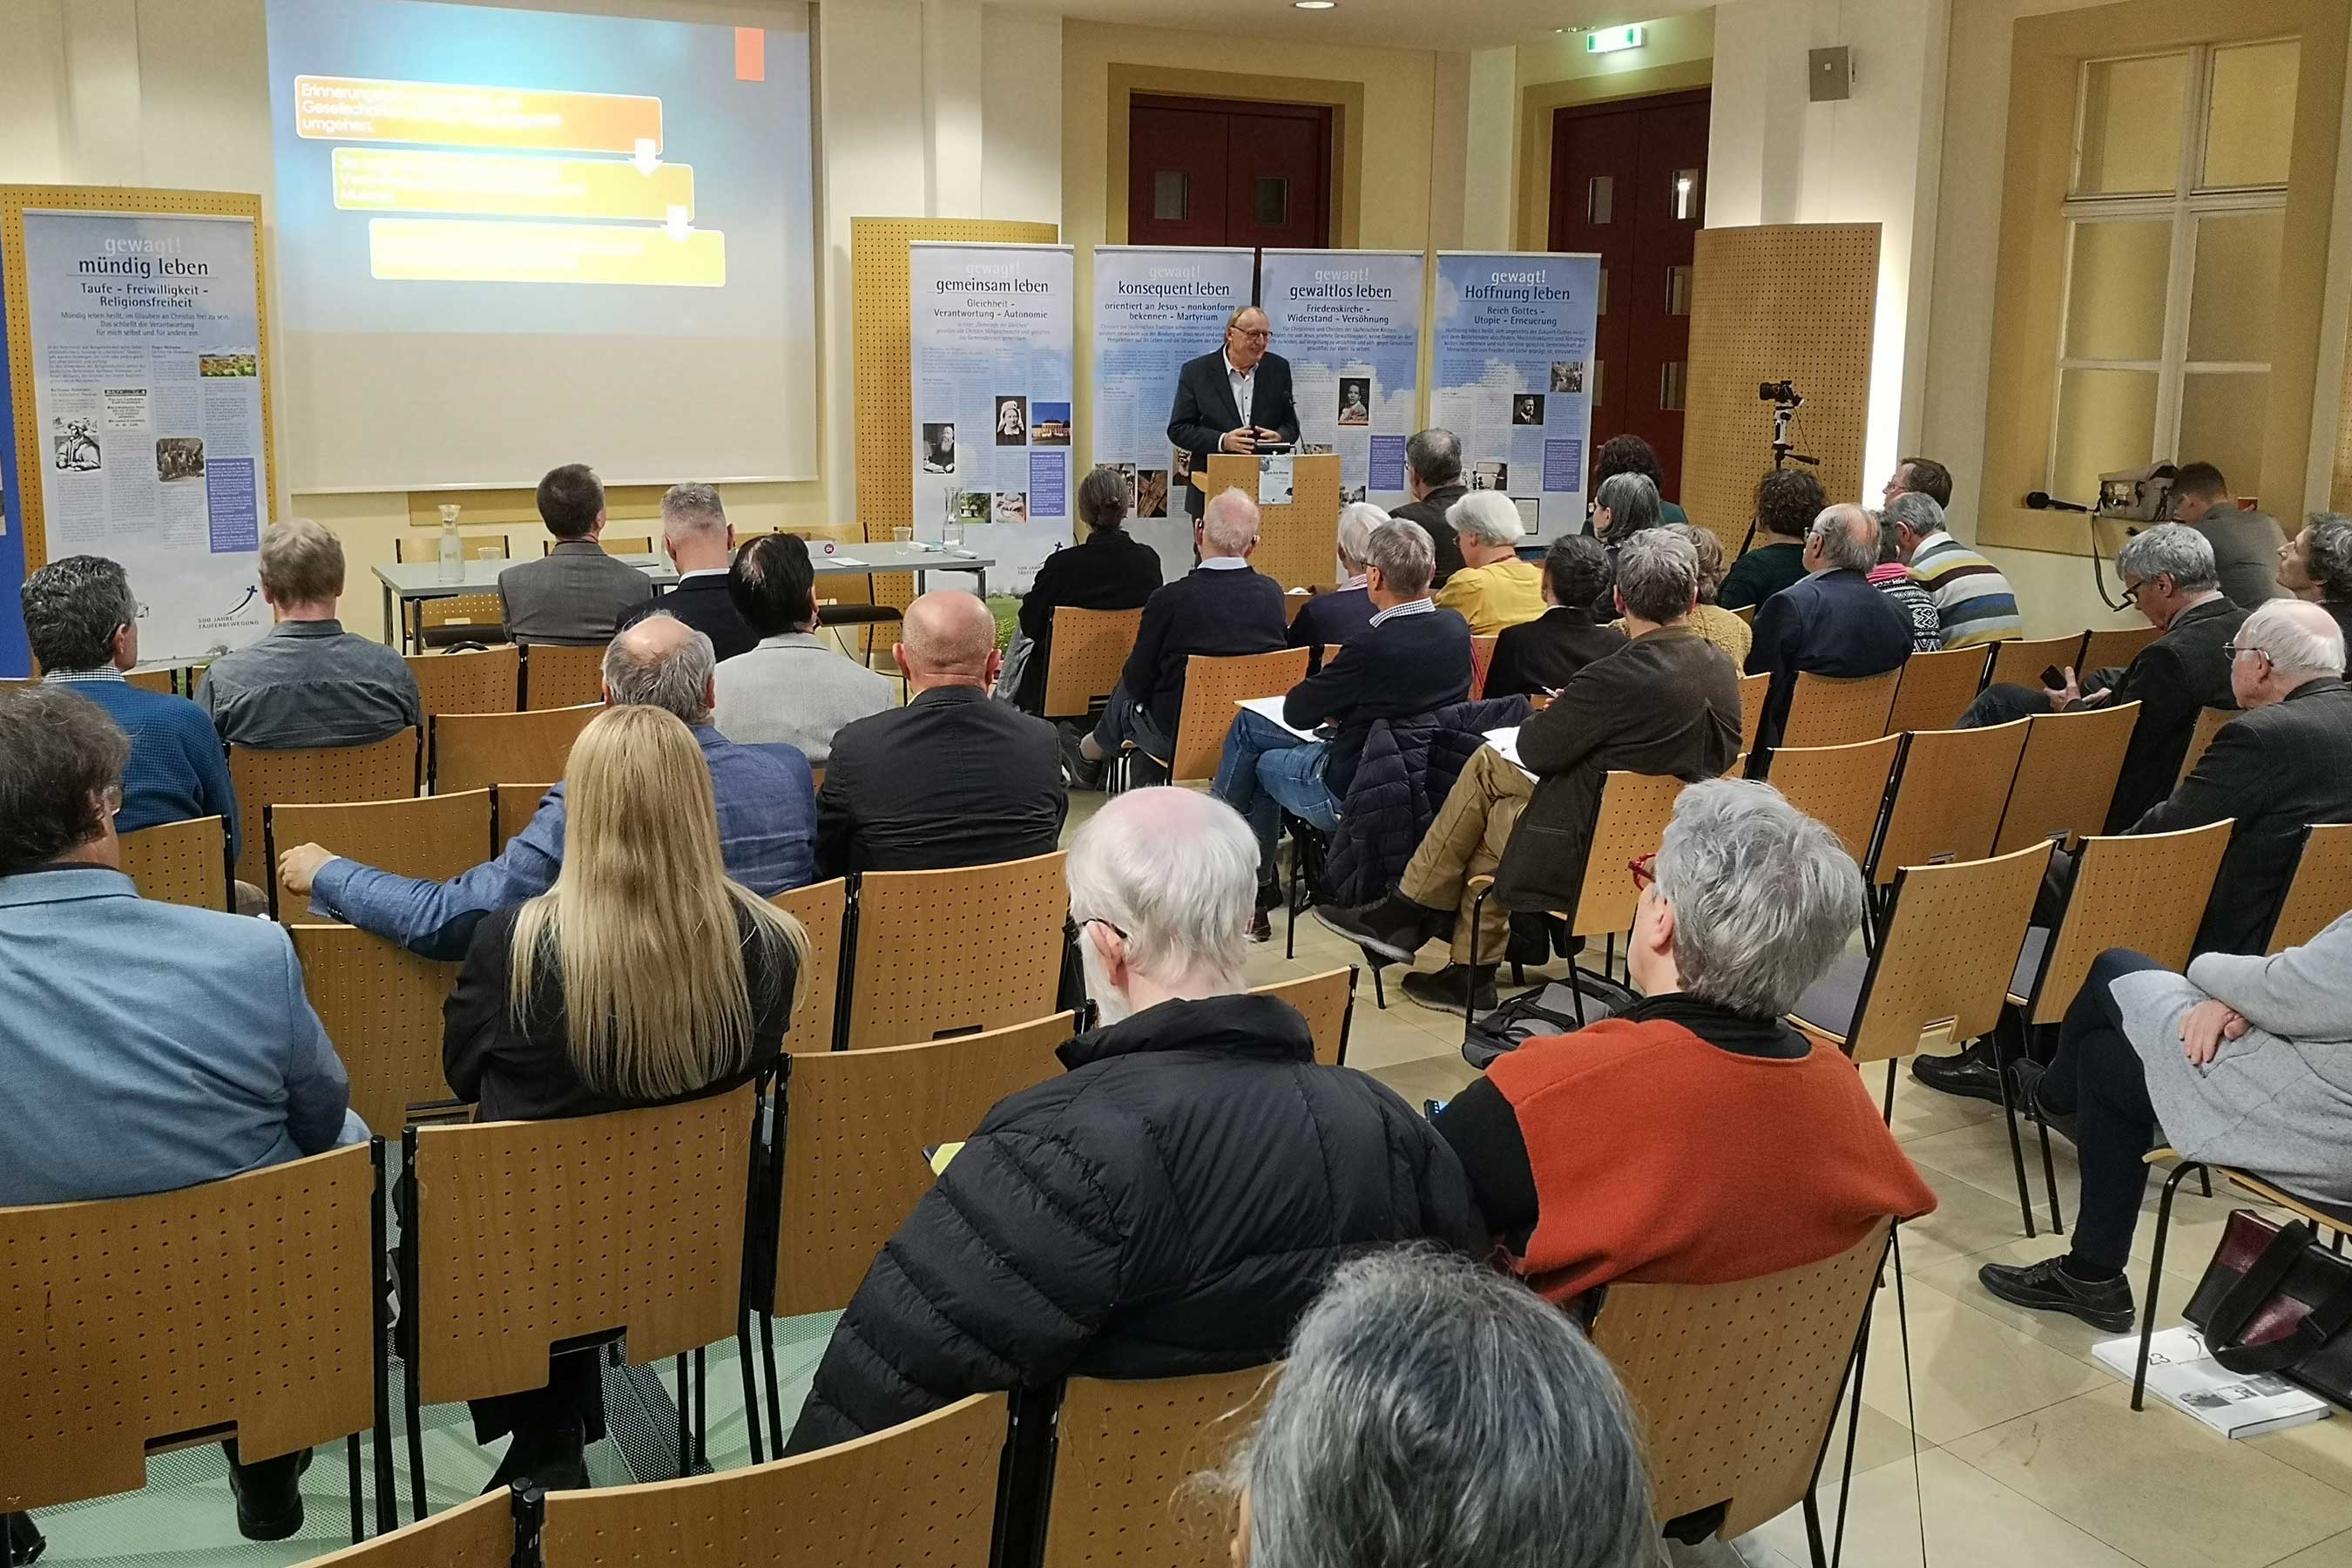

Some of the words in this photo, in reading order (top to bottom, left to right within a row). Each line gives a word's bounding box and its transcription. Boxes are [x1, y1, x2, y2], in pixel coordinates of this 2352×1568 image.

[105, 238, 181, 256] gewagt!
[78, 257, 152, 279] mündig
[159, 258, 209, 275] leben
[966, 261, 1020, 277] gewagt!
[1149, 265, 1200, 280] gewagt!
[1315, 267, 1369, 283] gewagt!
[1491, 269, 1546, 286] gewagt!
[81, 282, 112, 294] Taufe
[126, 283, 199, 297] Freiwilligkeit
[936, 277, 1010, 294] gemeinsam
[1015, 279, 1049, 293] leben
[1119, 280, 1193, 298] konsequent
[1196, 281, 1229, 295] leben
[1289, 284, 1353, 301] gewaltlos
[1356, 284, 1391, 298] leben
[1465, 285, 1530, 302] Hoffnung
[1534, 287, 1570, 300] leben
[100, 295, 193, 309] Religionsfreiheit
[967, 298, 1008, 308] Gleichheit
[1307, 304, 1363, 314] Friedenskirche
[934, 308, 995, 320] Verantwortung
[1004, 310, 1048, 319] Autonomie
[1177, 313, 1218, 322] Martyrium
[1487, 306, 1509, 314] Reich
[1511, 306, 1538, 315] Gottes
[1288, 314, 1333, 322] Widerstand
[1342, 314, 1389, 325] Versöhnung
[1474, 315, 1501, 326] Utopie
[1511, 316, 1557, 327] Erneuerung
